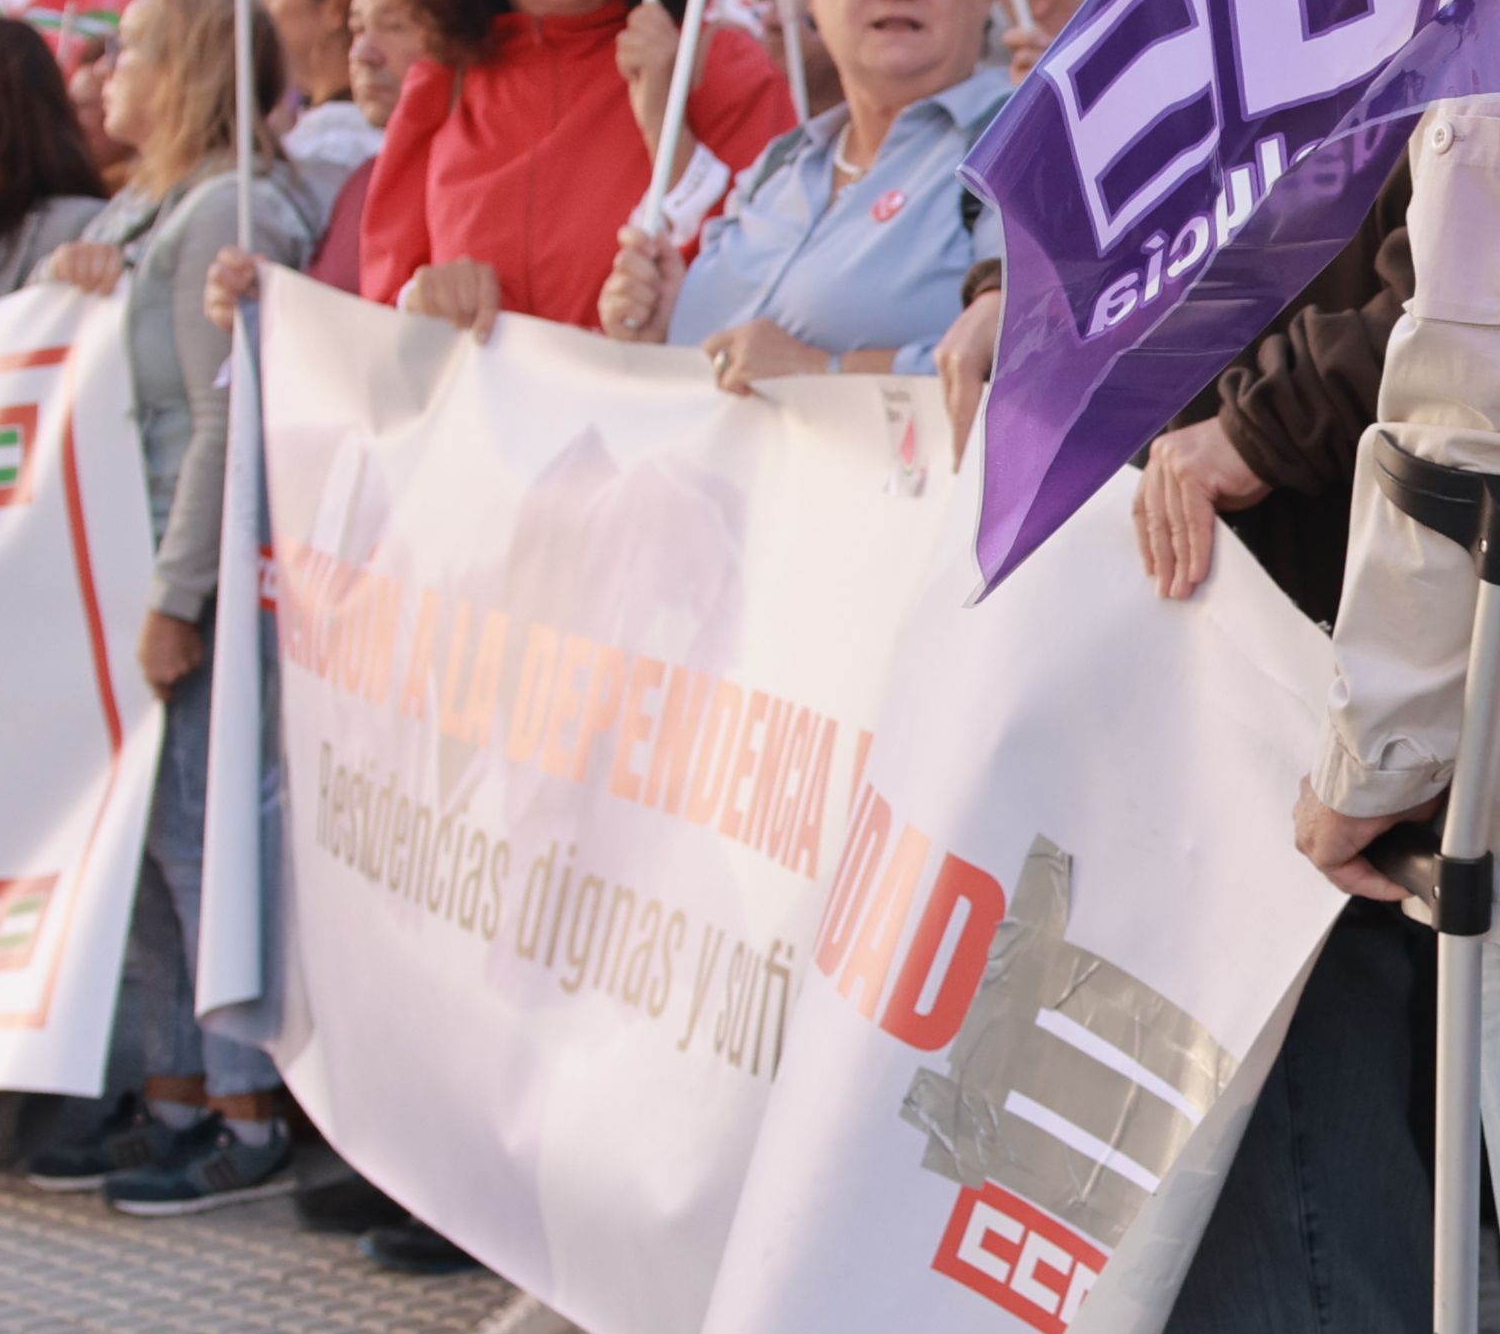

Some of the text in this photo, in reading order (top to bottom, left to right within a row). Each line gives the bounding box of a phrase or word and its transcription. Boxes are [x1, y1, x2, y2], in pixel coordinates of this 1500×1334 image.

[440, 600, 510, 748] LA
[506, 621, 839, 881] DEPENDENCIA
[316, 739, 796, 1083] Residencias dignas y sufi
